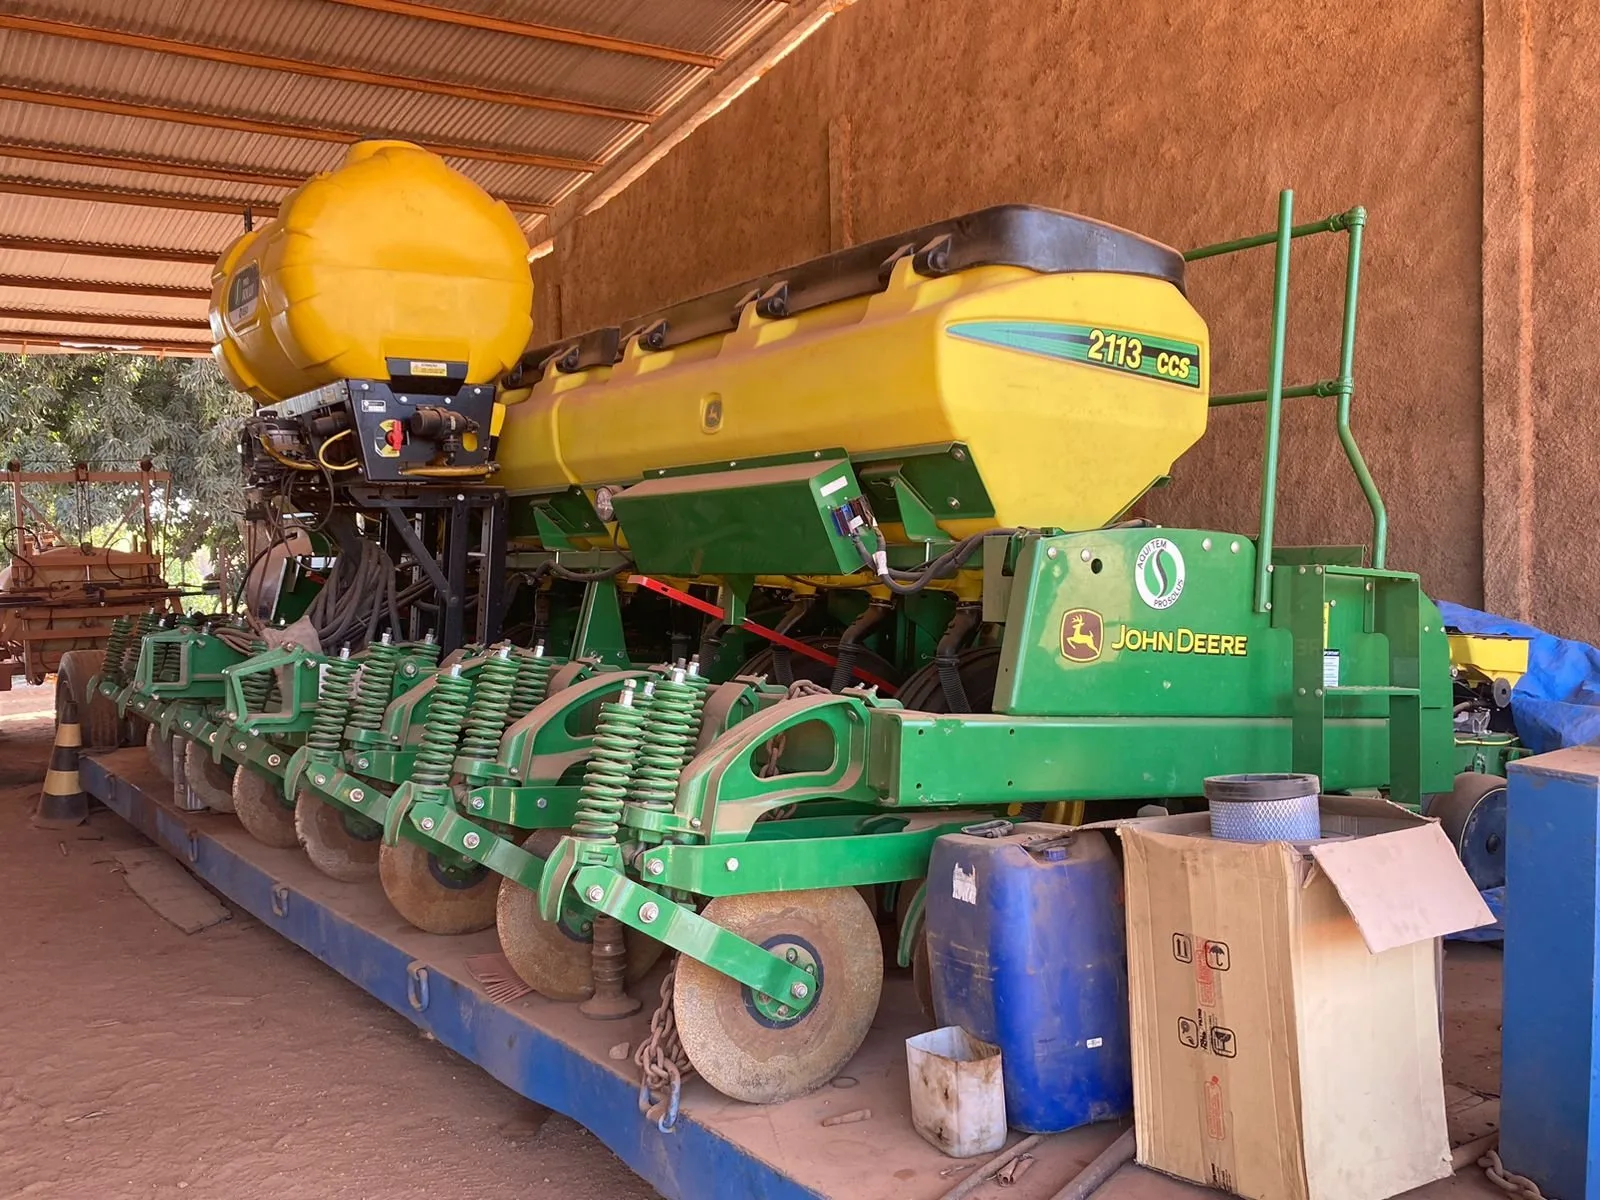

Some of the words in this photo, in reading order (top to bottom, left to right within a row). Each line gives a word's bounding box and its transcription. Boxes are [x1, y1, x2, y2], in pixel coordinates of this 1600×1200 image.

[1087, 328, 1142, 369] 2113
[1156, 351, 1191, 379] CCS
[1137, 546, 1151, 570] AQUI
[1150, 539, 1167, 550] TEM
[1153, 578, 1183, 608] PROSOLUS
[1111, 624, 1173, 653] JOHN
[1177, 628, 1248, 656] DEERE
